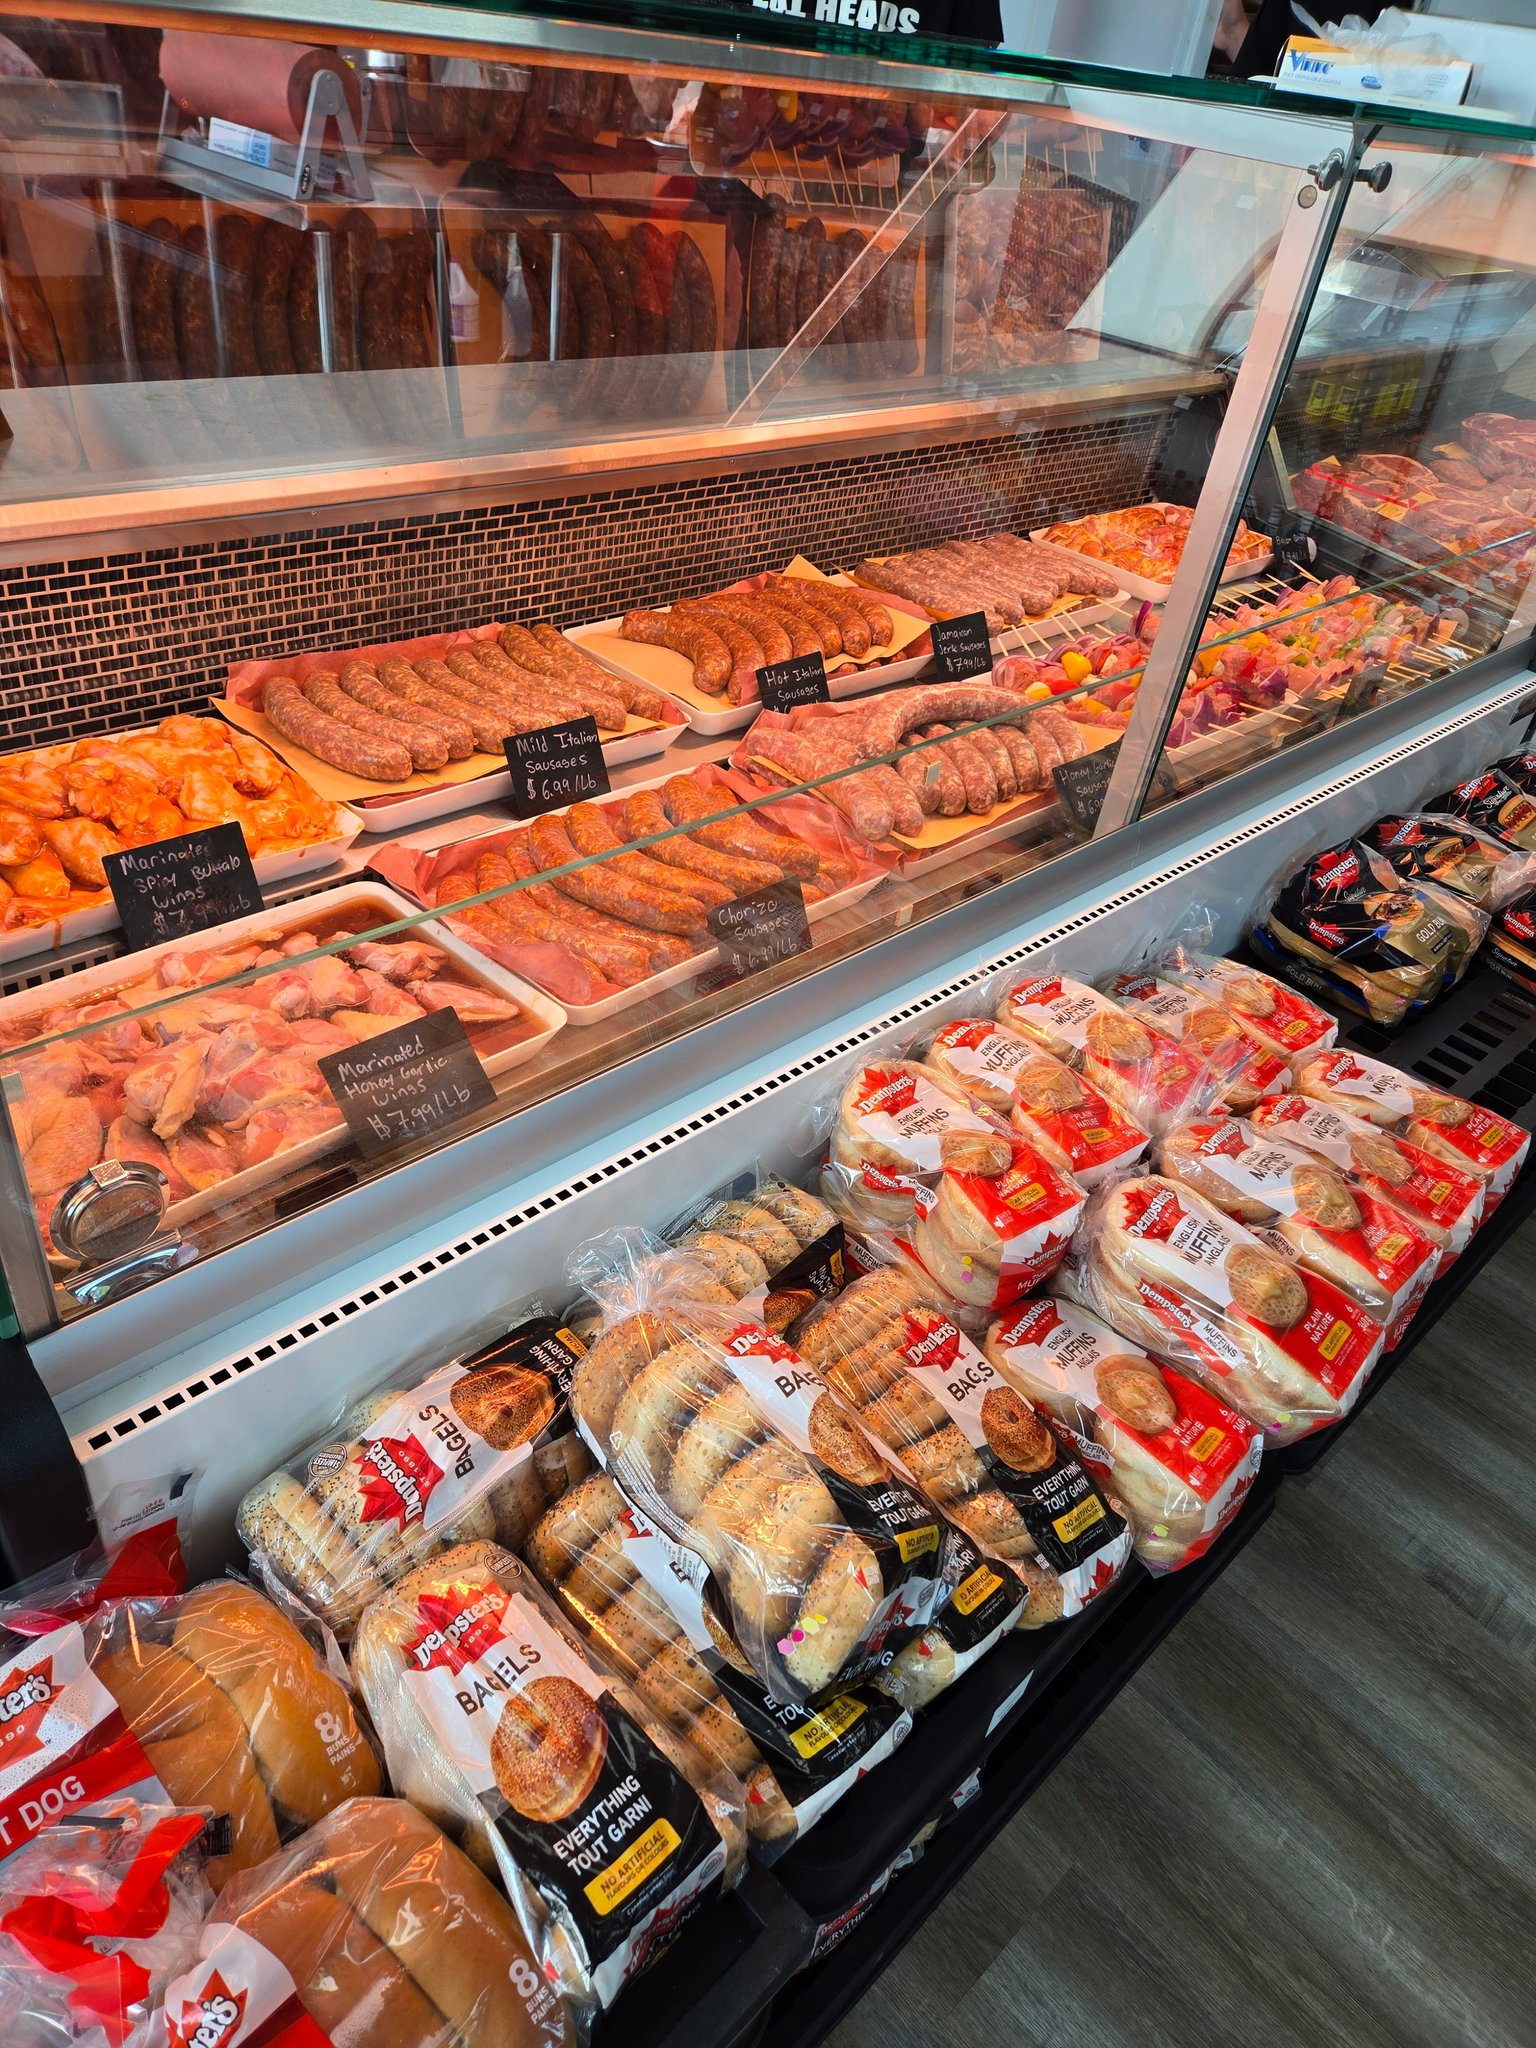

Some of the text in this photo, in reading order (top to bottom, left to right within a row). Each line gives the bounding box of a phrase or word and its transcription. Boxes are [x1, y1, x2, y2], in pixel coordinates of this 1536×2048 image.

[815, 0, 920, 34] HEADS
[939, 641, 986, 655] Jerk Sausages
[764, 666, 823, 687] Hot Italian
[777, 683, 820, 702] Sausages
[516, 731, 598, 757] Mild Italian
[1058, 767, 1091, 786] Honey
[1315, 854, 1359, 889] Dempster's
[718, 899, 778, 926] Chorizo
[1504, 913, 1535, 937] Dempster's
[734, 915, 790, 941] Sausages
[1308, 921, 1346, 946] Dempster's
[1416, 923, 1437, 942] GOLD
[1491, 947, 1518, 967] Signature
[1285, 965, 1306, 982] GOLD
[1055, 997, 1096, 1026] MUFFINS
[338, 1034, 425, 1082] Marinated
[1002, 1049, 1032, 1073] ANGLAIS
[344, 1056, 448, 1100] Honey Garlic
[372, 1079, 428, 1107] Wings
[860, 1075, 915, 1113] Dempster's
[897, 1105, 927, 1126] ENGLISH
[900, 1107, 951, 1140] MUFFINS
[1201, 1122, 1240, 1155] Dempster's
[861, 1163, 900, 1188] Dempster's
[994, 1172, 1020, 1189] PLAIN
[1128, 1188, 1175, 1237] Dempster's
[1173, 1218, 1201, 1249] ENGLISH
[1180, 1219, 1224, 1265] MUFFINS
[1266, 1230, 1297, 1257] MUFFINS
[854, 1245, 884, 1269] MUFFINS
[1203, 1235, 1232, 1267] ANGLAIS
[1139, 1282, 1193, 1328] Dempster's
[1345, 1304, 1354, 1313] 6
[1001, 1299, 1055, 1347] Dempster's
[1303, 1308, 1323, 1333] PLAIN
[1309, 1312, 1335, 1344] NATURE
[541, 1339, 573, 1365] GARNI
[1047, 1328, 1074, 1350] ENGLISH
[1056, 1331, 1098, 1371] MUFFINS
[1202, 1321, 1239, 1359] MUFFINS
[529, 1345, 572, 1393] ERYTHING
[1075, 1350, 1101, 1371] ANGLAIS
[1219, 1407, 1229, 1417] 6
[1172, 1417, 1192, 1437] PLAIN
[1179, 1421, 1205, 1447] NATURE
[418, 1404, 475, 1479] BAGELS
[1074, 1433, 1111, 1461] MUFFINS
[397, 1450, 433, 1488] ST 1890
[1031, 1460, 1082, 1500] EVERYTHING
[1043, 1489, 1070, 1514] TOUT
[1063, 1500, 1098, 1530] NO ARTIFICIAL
[905, 1537, 915, 1549] NO
[413, 1593, 505, 1669] Depster's
[463, 1623, 490, 1649] 1890
[314, 1711, 341, 1743] 8
[775, 1703, 805, 1726] TOU
[326, 1735, 350, 1757] BUNS
[803, 1726, 819, 1741] NO
[330, 1743, 357, 1766] PAINS
[19, 1775, 86, 1831] DOG
[552, 1774, 641, 1860] EVERYTHING
[567, 1794, 653, 1877] TOUT GARNI
[601, 1829, 665, 1893] NO ARTIFICIAL
[606, 1838, 670, 1901] FLAVOURS OR COLOURS
[508, 1958, 539, 1998] 8
[525, 1985, 549, 2014] BUNS
[530, 1994, 556, 2025] PAINS
